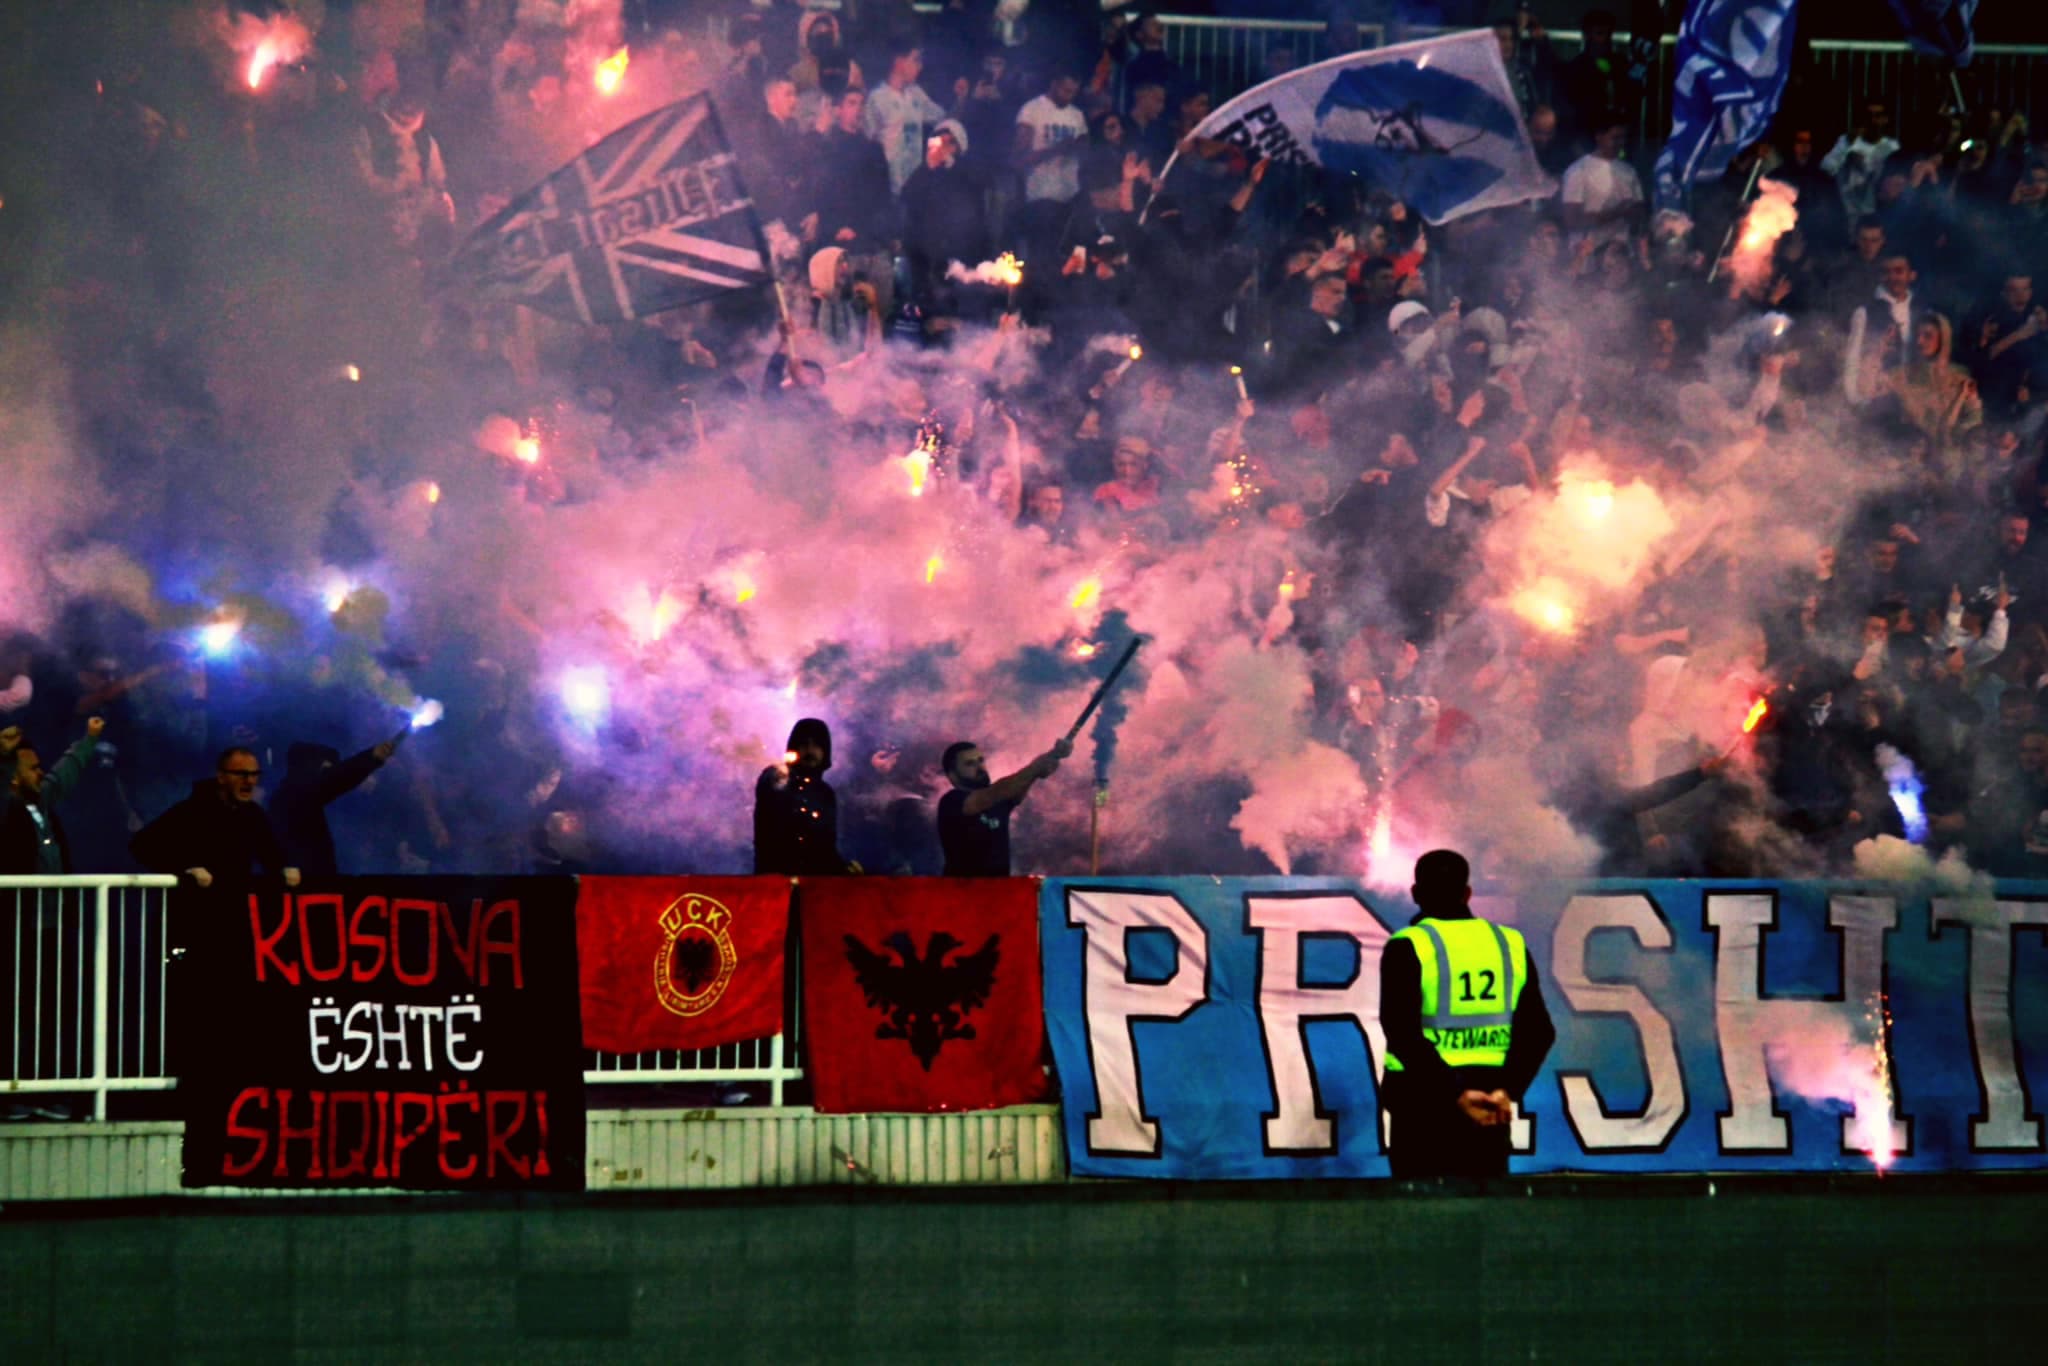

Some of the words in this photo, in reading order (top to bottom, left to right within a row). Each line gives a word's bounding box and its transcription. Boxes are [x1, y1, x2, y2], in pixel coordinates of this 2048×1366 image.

[248, 893, 524, 990] KOSOVA
[1458, 969, 1497, 1001] 12
[308, 994, 485, 1074] ËSHTË
[1066, 888, 2048, 1158] PRSHT
[222, 1080, 550, 1179] SHQIPËRI
